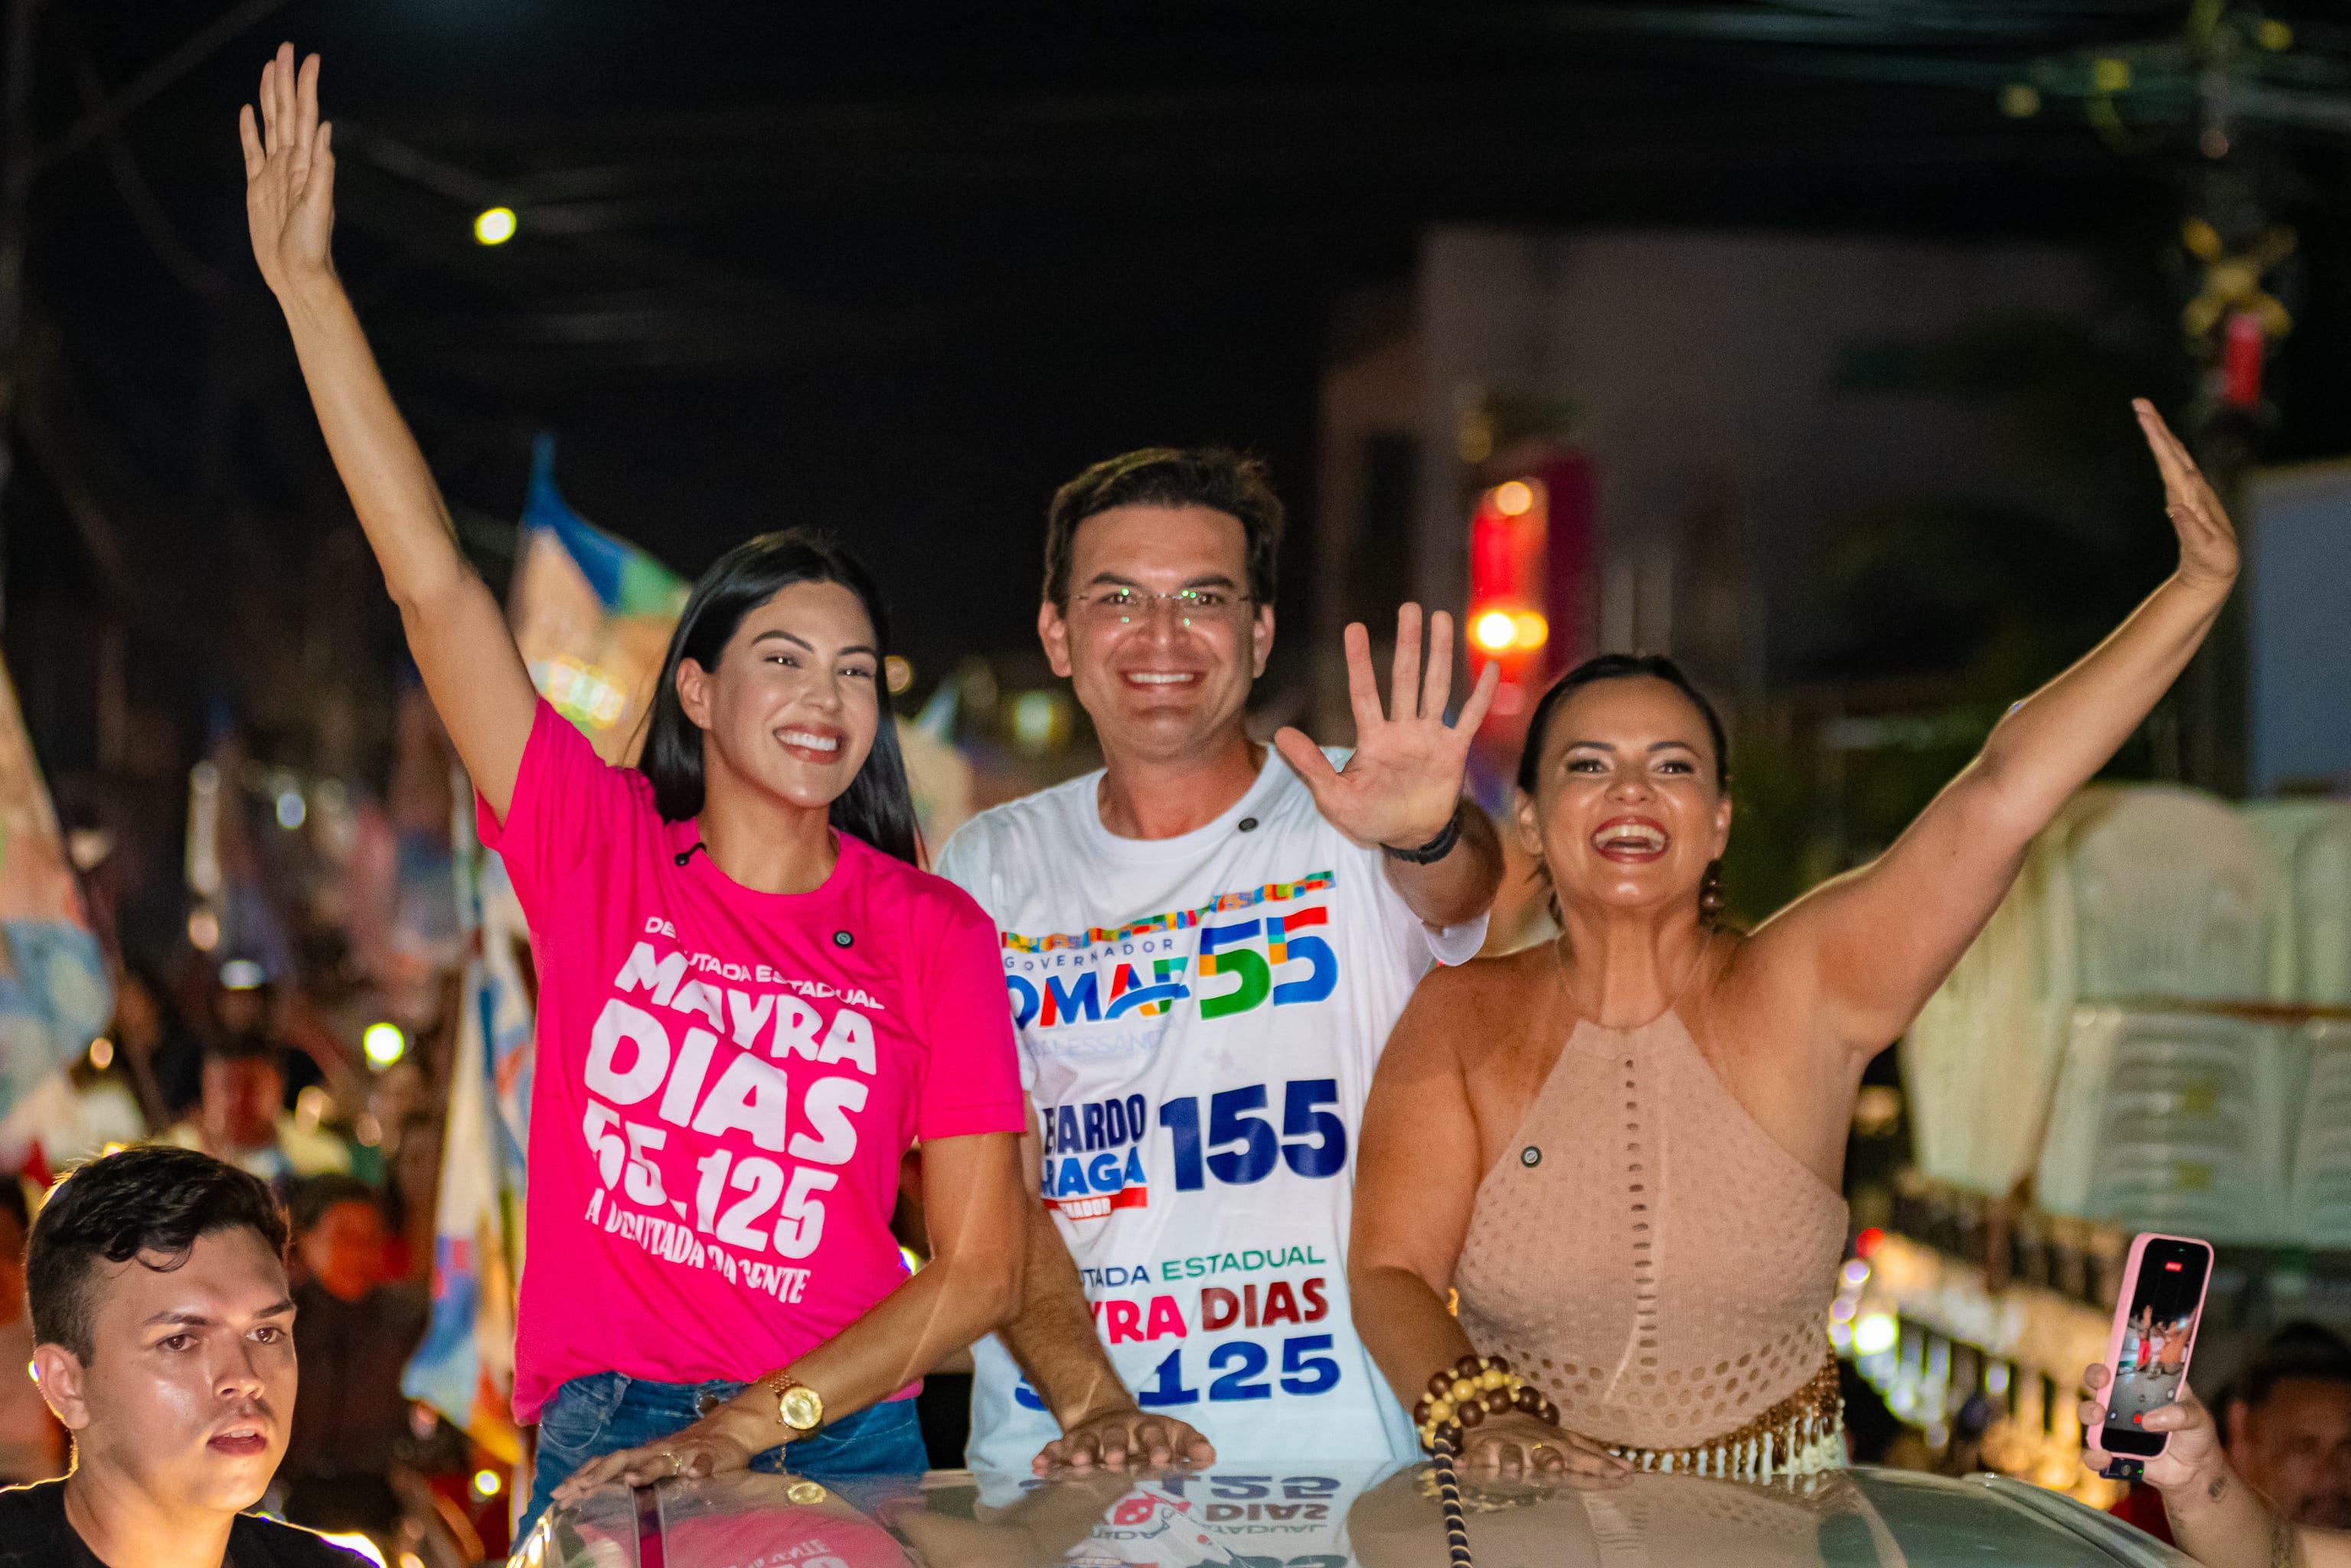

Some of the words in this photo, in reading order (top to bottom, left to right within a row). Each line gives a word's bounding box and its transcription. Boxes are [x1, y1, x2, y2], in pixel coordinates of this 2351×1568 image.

[645, 917, 753, 982] DEUTADA
[1004, 938, 1174, 972] GOVERNADOR
[1199, 906, 1338, 1021] 55
[615, 941, 877, 1076] MAYRA
[584, 998, 869, 1165] DIAS
[1160, 1079, 1347, 1192] 155
[584, 1187, 605, 1226] A
[1161, 1246, 1326, 1281] ESTADUAL
[1201, 1277, 1329, 1332] DIAS
